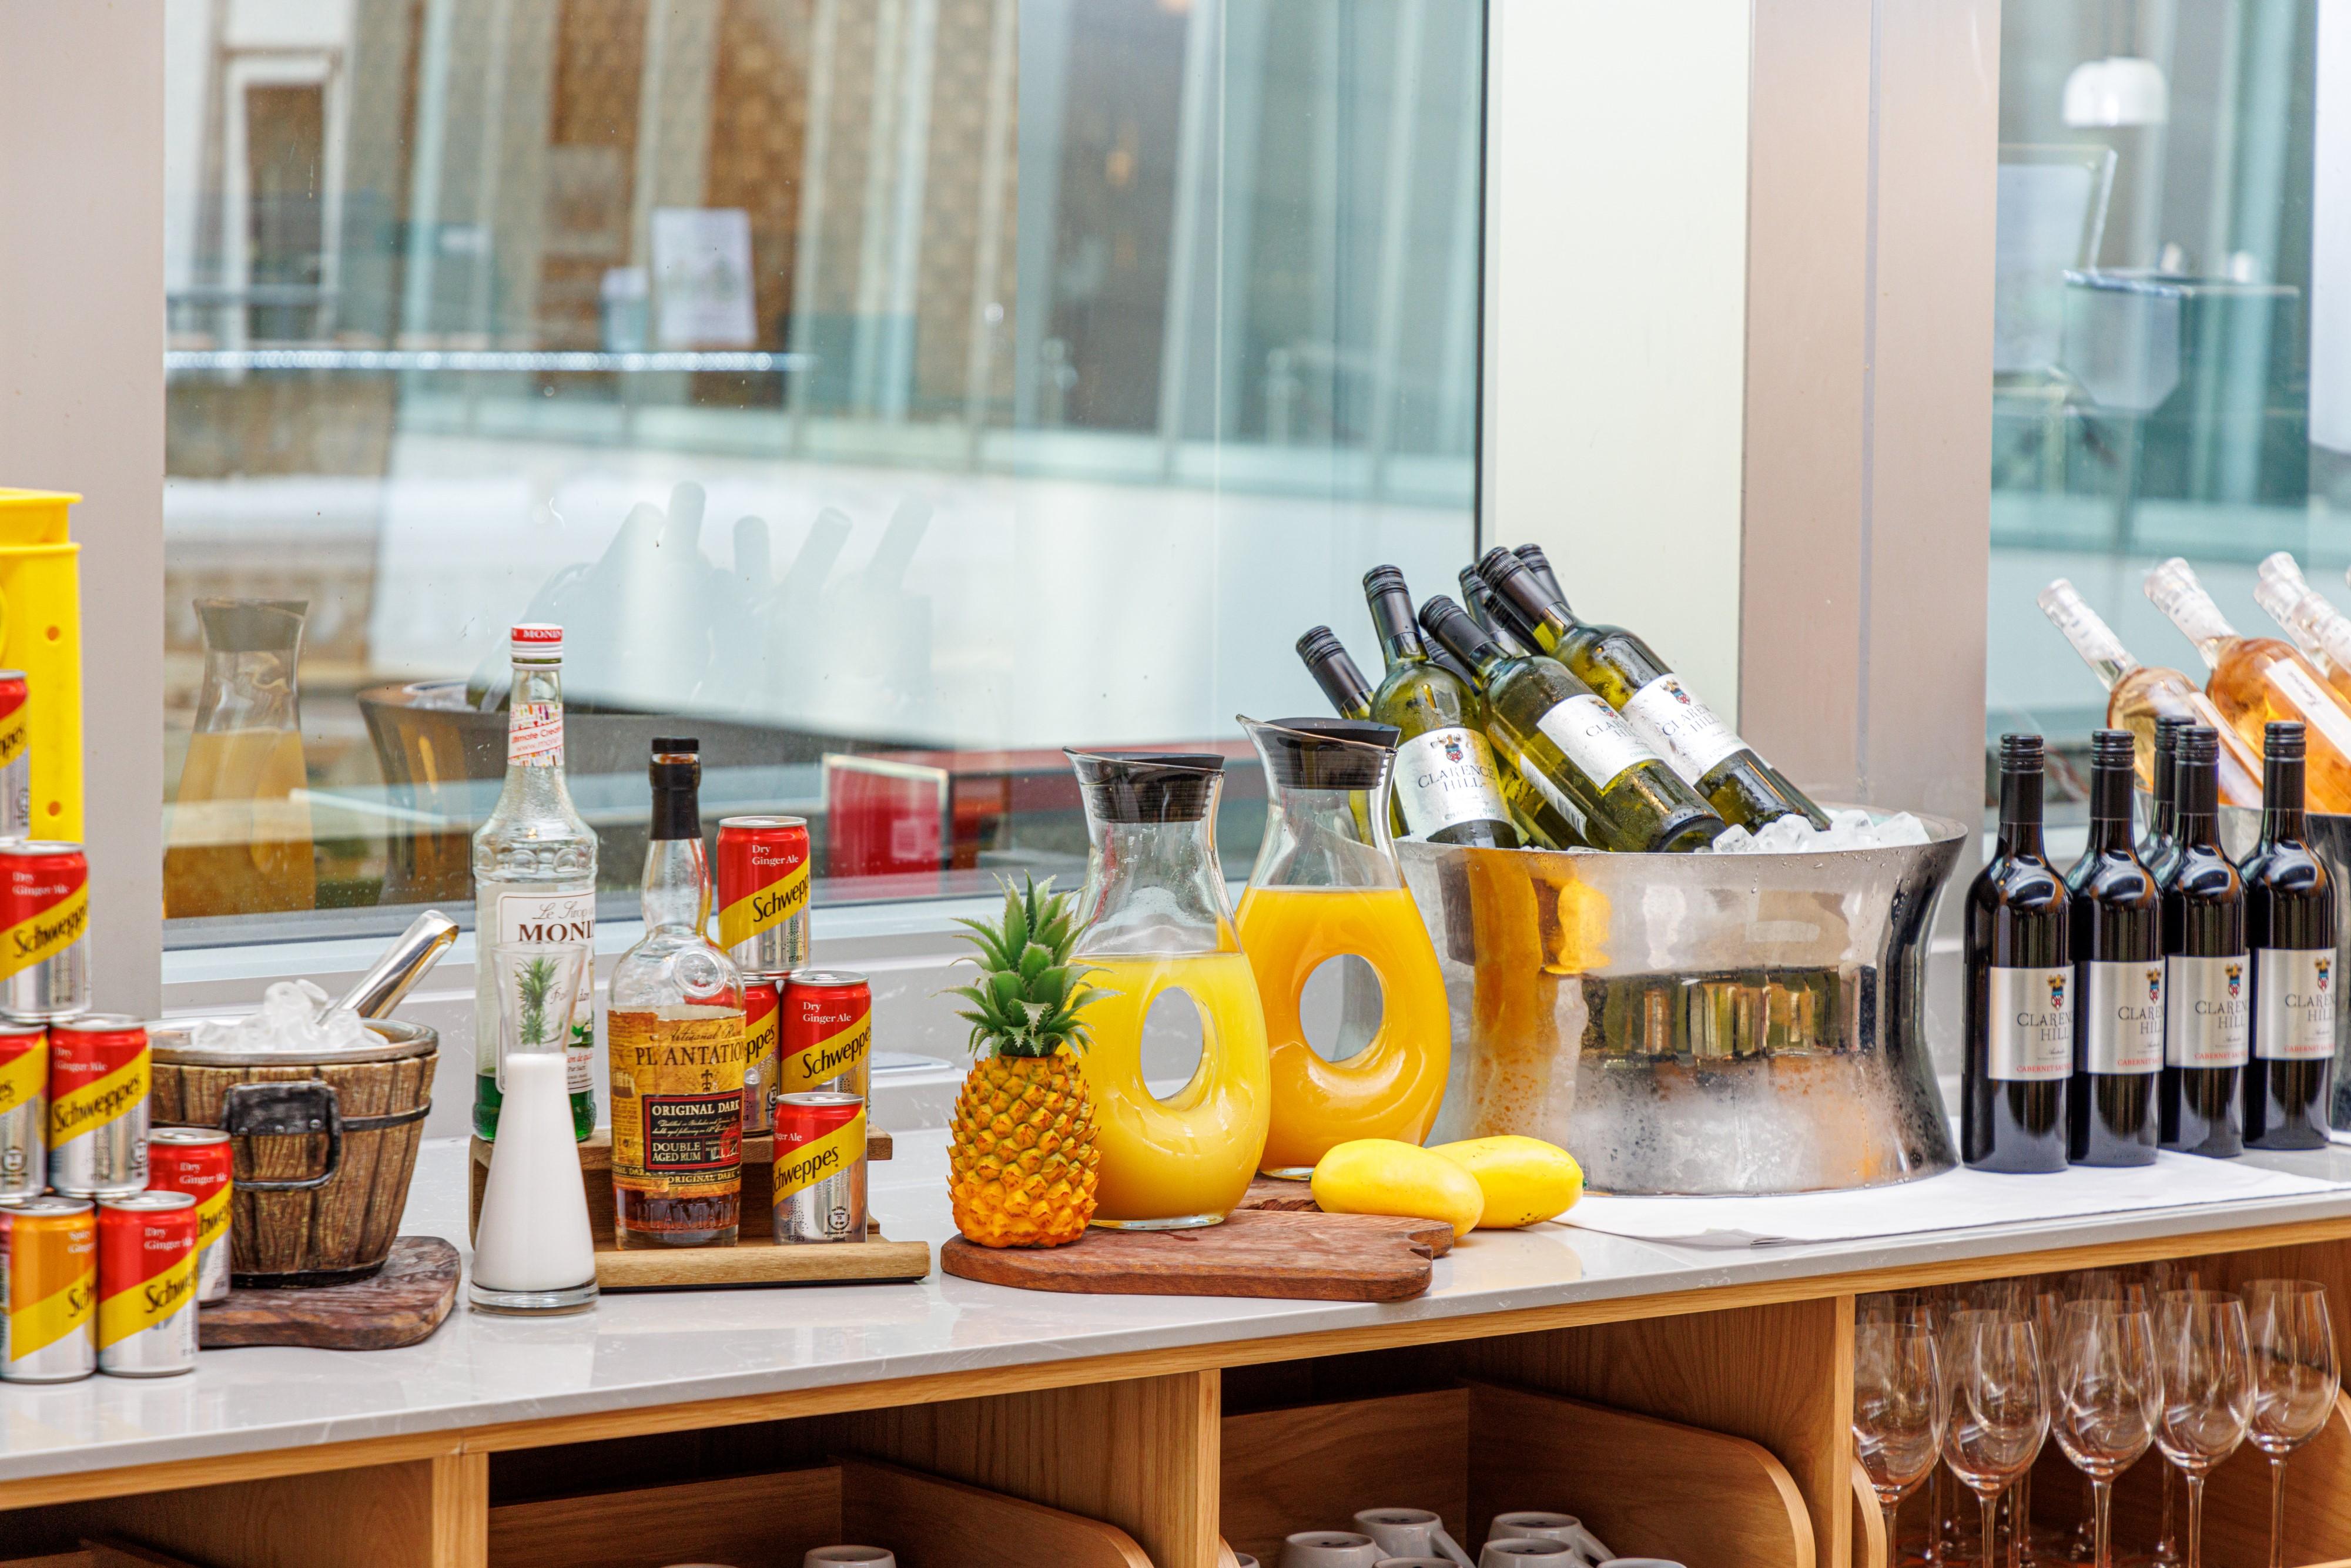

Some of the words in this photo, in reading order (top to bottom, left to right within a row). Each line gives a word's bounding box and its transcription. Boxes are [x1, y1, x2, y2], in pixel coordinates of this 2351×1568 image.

[1662, 704, 1711, 736] CLAREN
[1418, 764, 1496, 789] CLARENCE
[1444, 776, 1483, 792] HILL
[752, 845, 771, 856] Dry
[752, 857, 785, 866] Ginger
[786, 855, 799, 863] Ale
[752, 873, 809, 923] Schwepp
[531, 902, 555, 920] Le
[803, 1001, 822, 1013] Dry
[2195, 1000, 2248, 1015] CLAREN
[2285, 993, 2335, 1008] CLAREN
[803, 1013, 836, 1024] Ginger
[836, 1013, 852, 1022] Ale
[2017, 1010, 2072, 1027] CLAREN
[2218, 1016, 2245, 1029] HILL
[2041, 1027, 2069, 1041] HILL
[652, 1104, 715, 1116] ORIGINAL
[718, 1100, 740, 1114] DARK
[788, 1133, 802, 1141] Ale
[652, 1142, 701, 1152] DOUBLE
[652, 1152, 679, 1161] AGED
[680, 1151, 701, 1161] RUM
[668, 1173, 715, 1184] ORIGINAL
[717, 1171, 735, 1181] DARK
